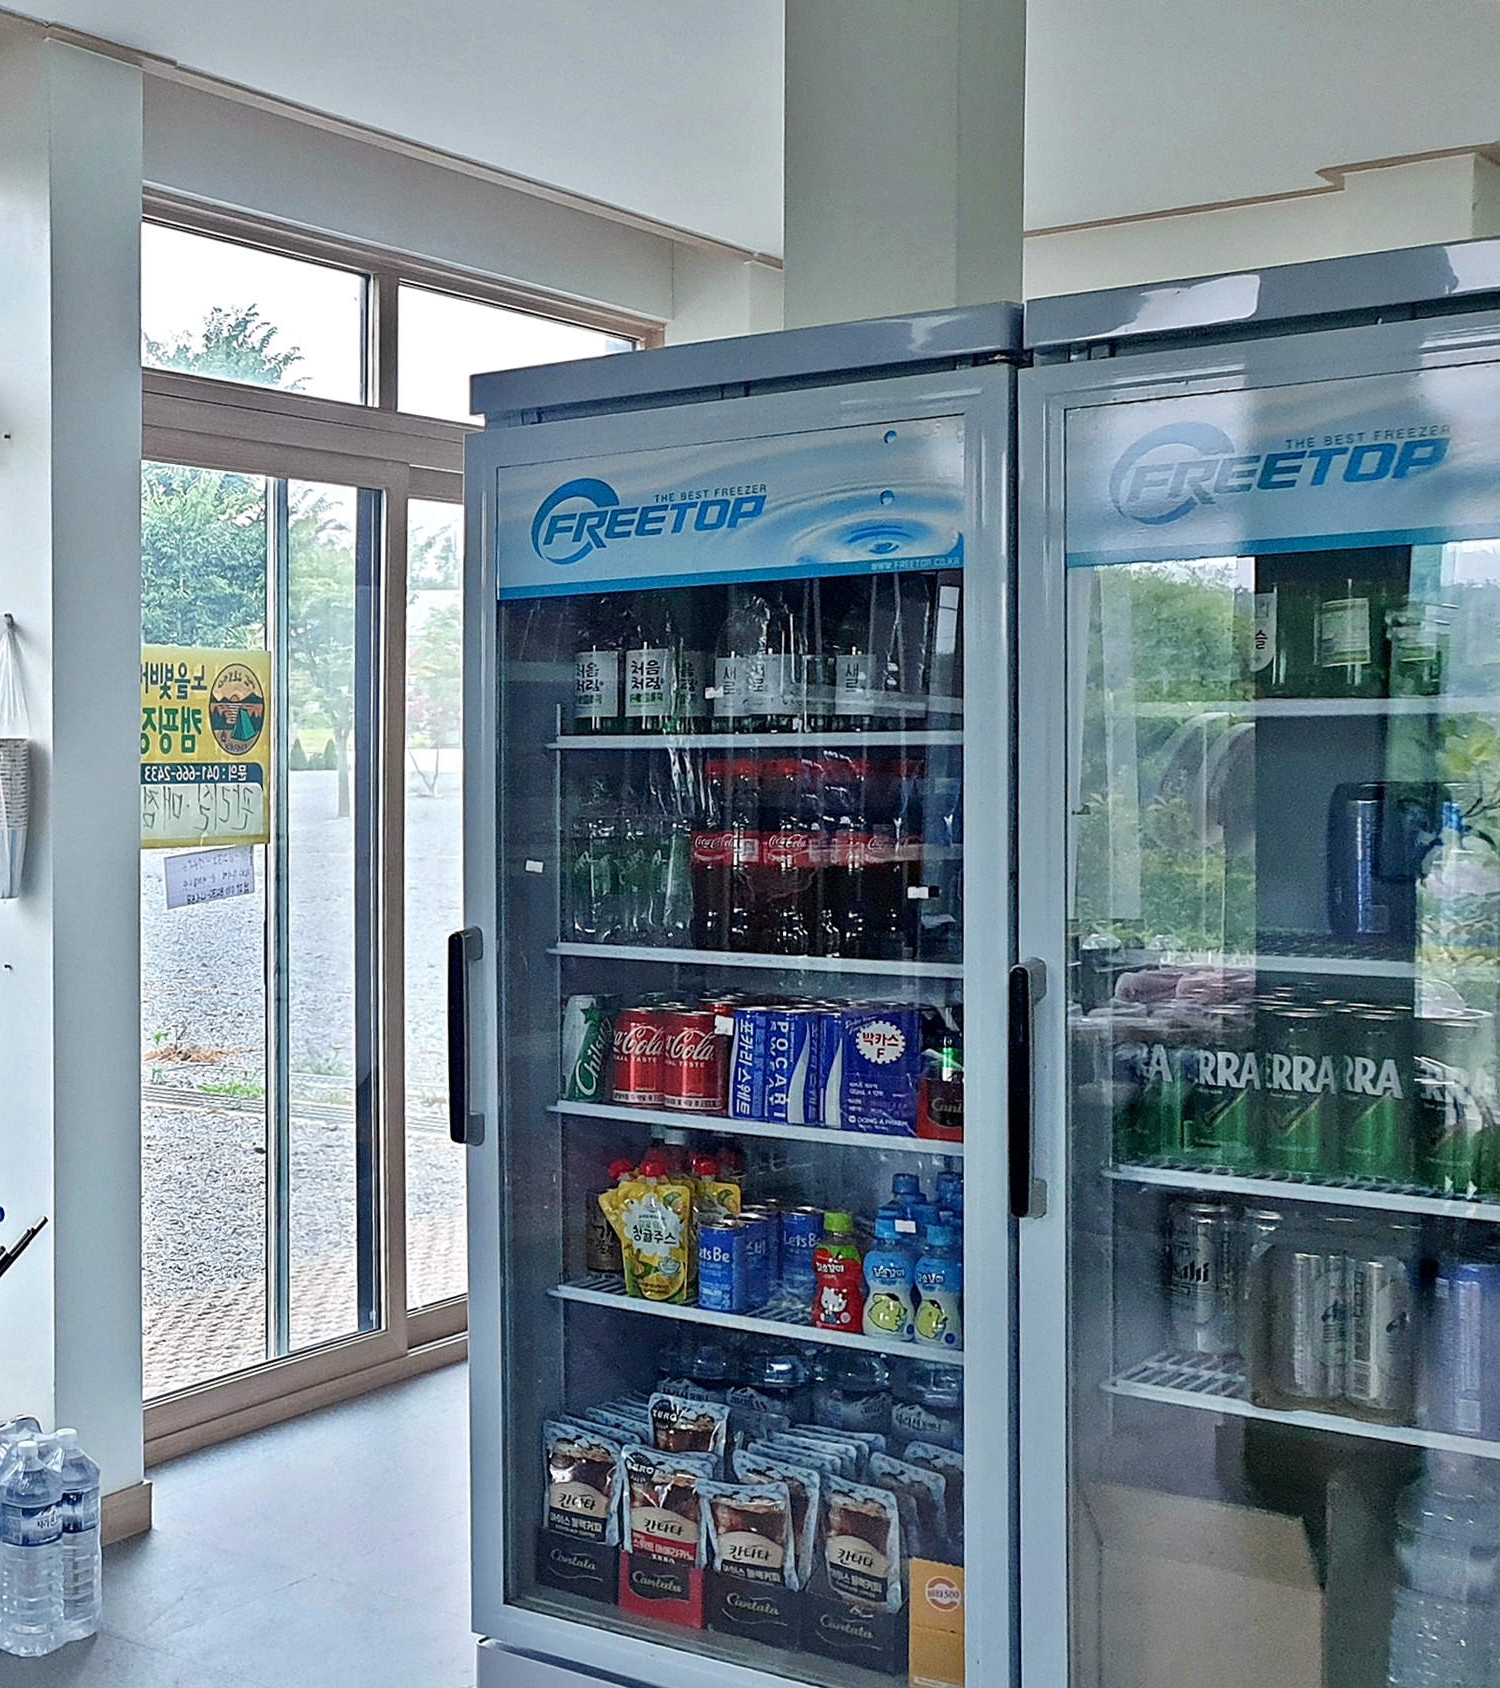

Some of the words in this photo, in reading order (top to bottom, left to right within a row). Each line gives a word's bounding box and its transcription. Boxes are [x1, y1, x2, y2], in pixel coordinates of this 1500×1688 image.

[1284, 438, 1315, 450] THE
[1325, 432, 1365, 447] BEST
[1373, 424, 1452, 441] FREEZER
[1124, 437, 1453, 506] FREETOP
[654, 492, 677, 504] THE
[681, 489, 710, 501] BEST
[713, 483, 768, 499] FREEZER
[542, 494, 767, 549] FREETOP
[630, 660, 662, 677] 처음
[631, 676, 664, 692] 처럼
[862, 1033, 901, 1048] 박카스
[876, 1048, 886, 1059] F
[773, 1021, 789, 1119] POCARI
[1200, 1050, 1261, 1090] RRA
[931, 1098, 964, 1114] Cant
[652, 1408, 678, 1422] ZERO
[644, 1517, 684, 1536] 칸타타
[550, 1549, 596, 1571] Cantata
[729, 1544, 773, 1561] 칸타타
[838, 1548, 876, 1569] 칸타타
[631, 1570, 683, 1593] Cantata
[726, 1592, 780, 1616] Cantata
[819, 1614, 874, 1639] Cantata
